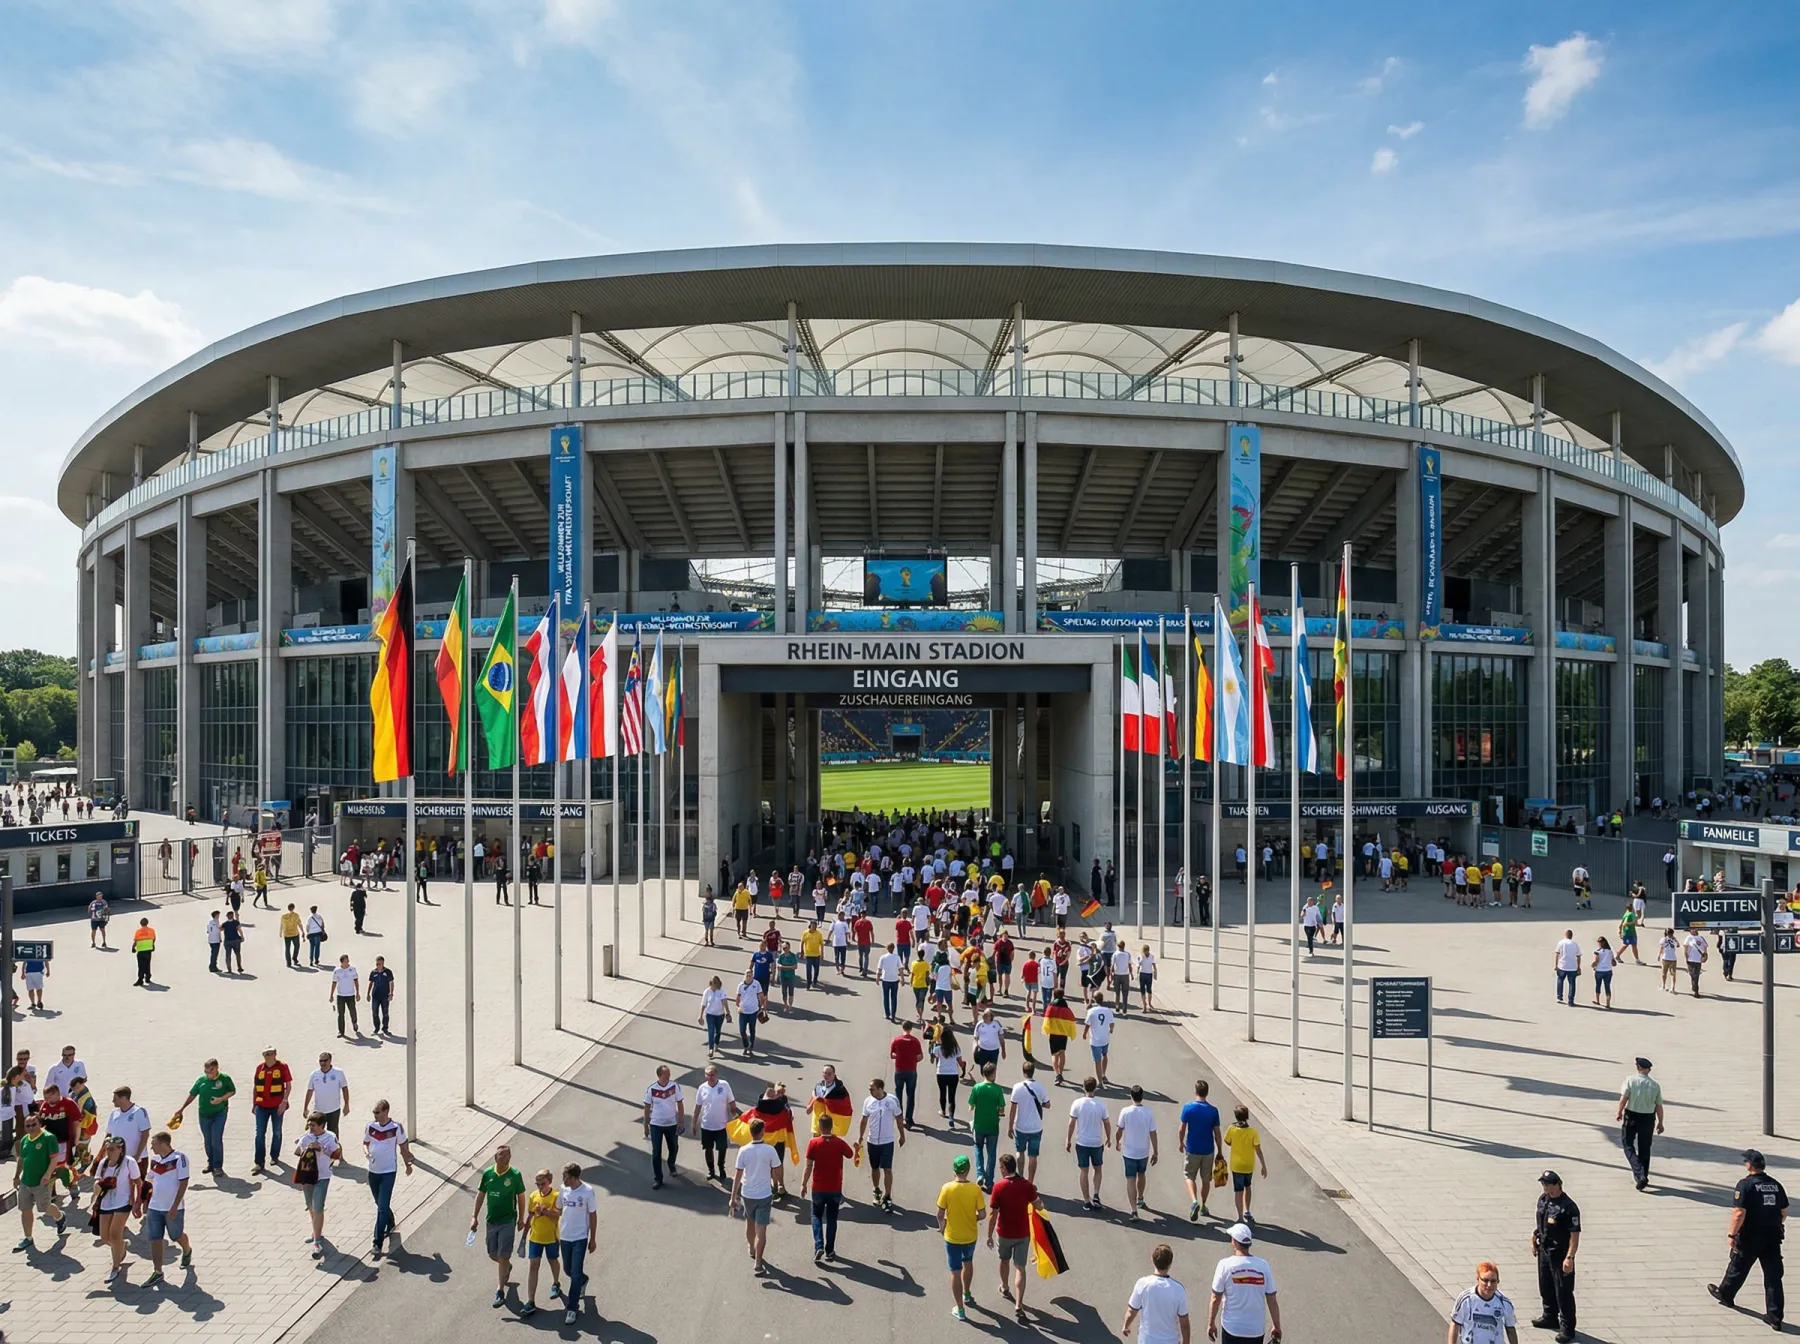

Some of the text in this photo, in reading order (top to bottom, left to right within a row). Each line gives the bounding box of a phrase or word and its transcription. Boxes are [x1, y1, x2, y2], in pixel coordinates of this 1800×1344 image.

[787, 642, 1024, 660] RHEIN-MAIN STADION
[852, 669, 959, 688] EINGANG
[1425, 804, 1468, 815] AUSGANG
[28, 828, 78, 843] TICKETS
[1703, 826, 1755, 842] FANMEILE
[1680, 899, 1758, 912] AUSIETTEN
[1097, 1013, 1106, 1026] 9
